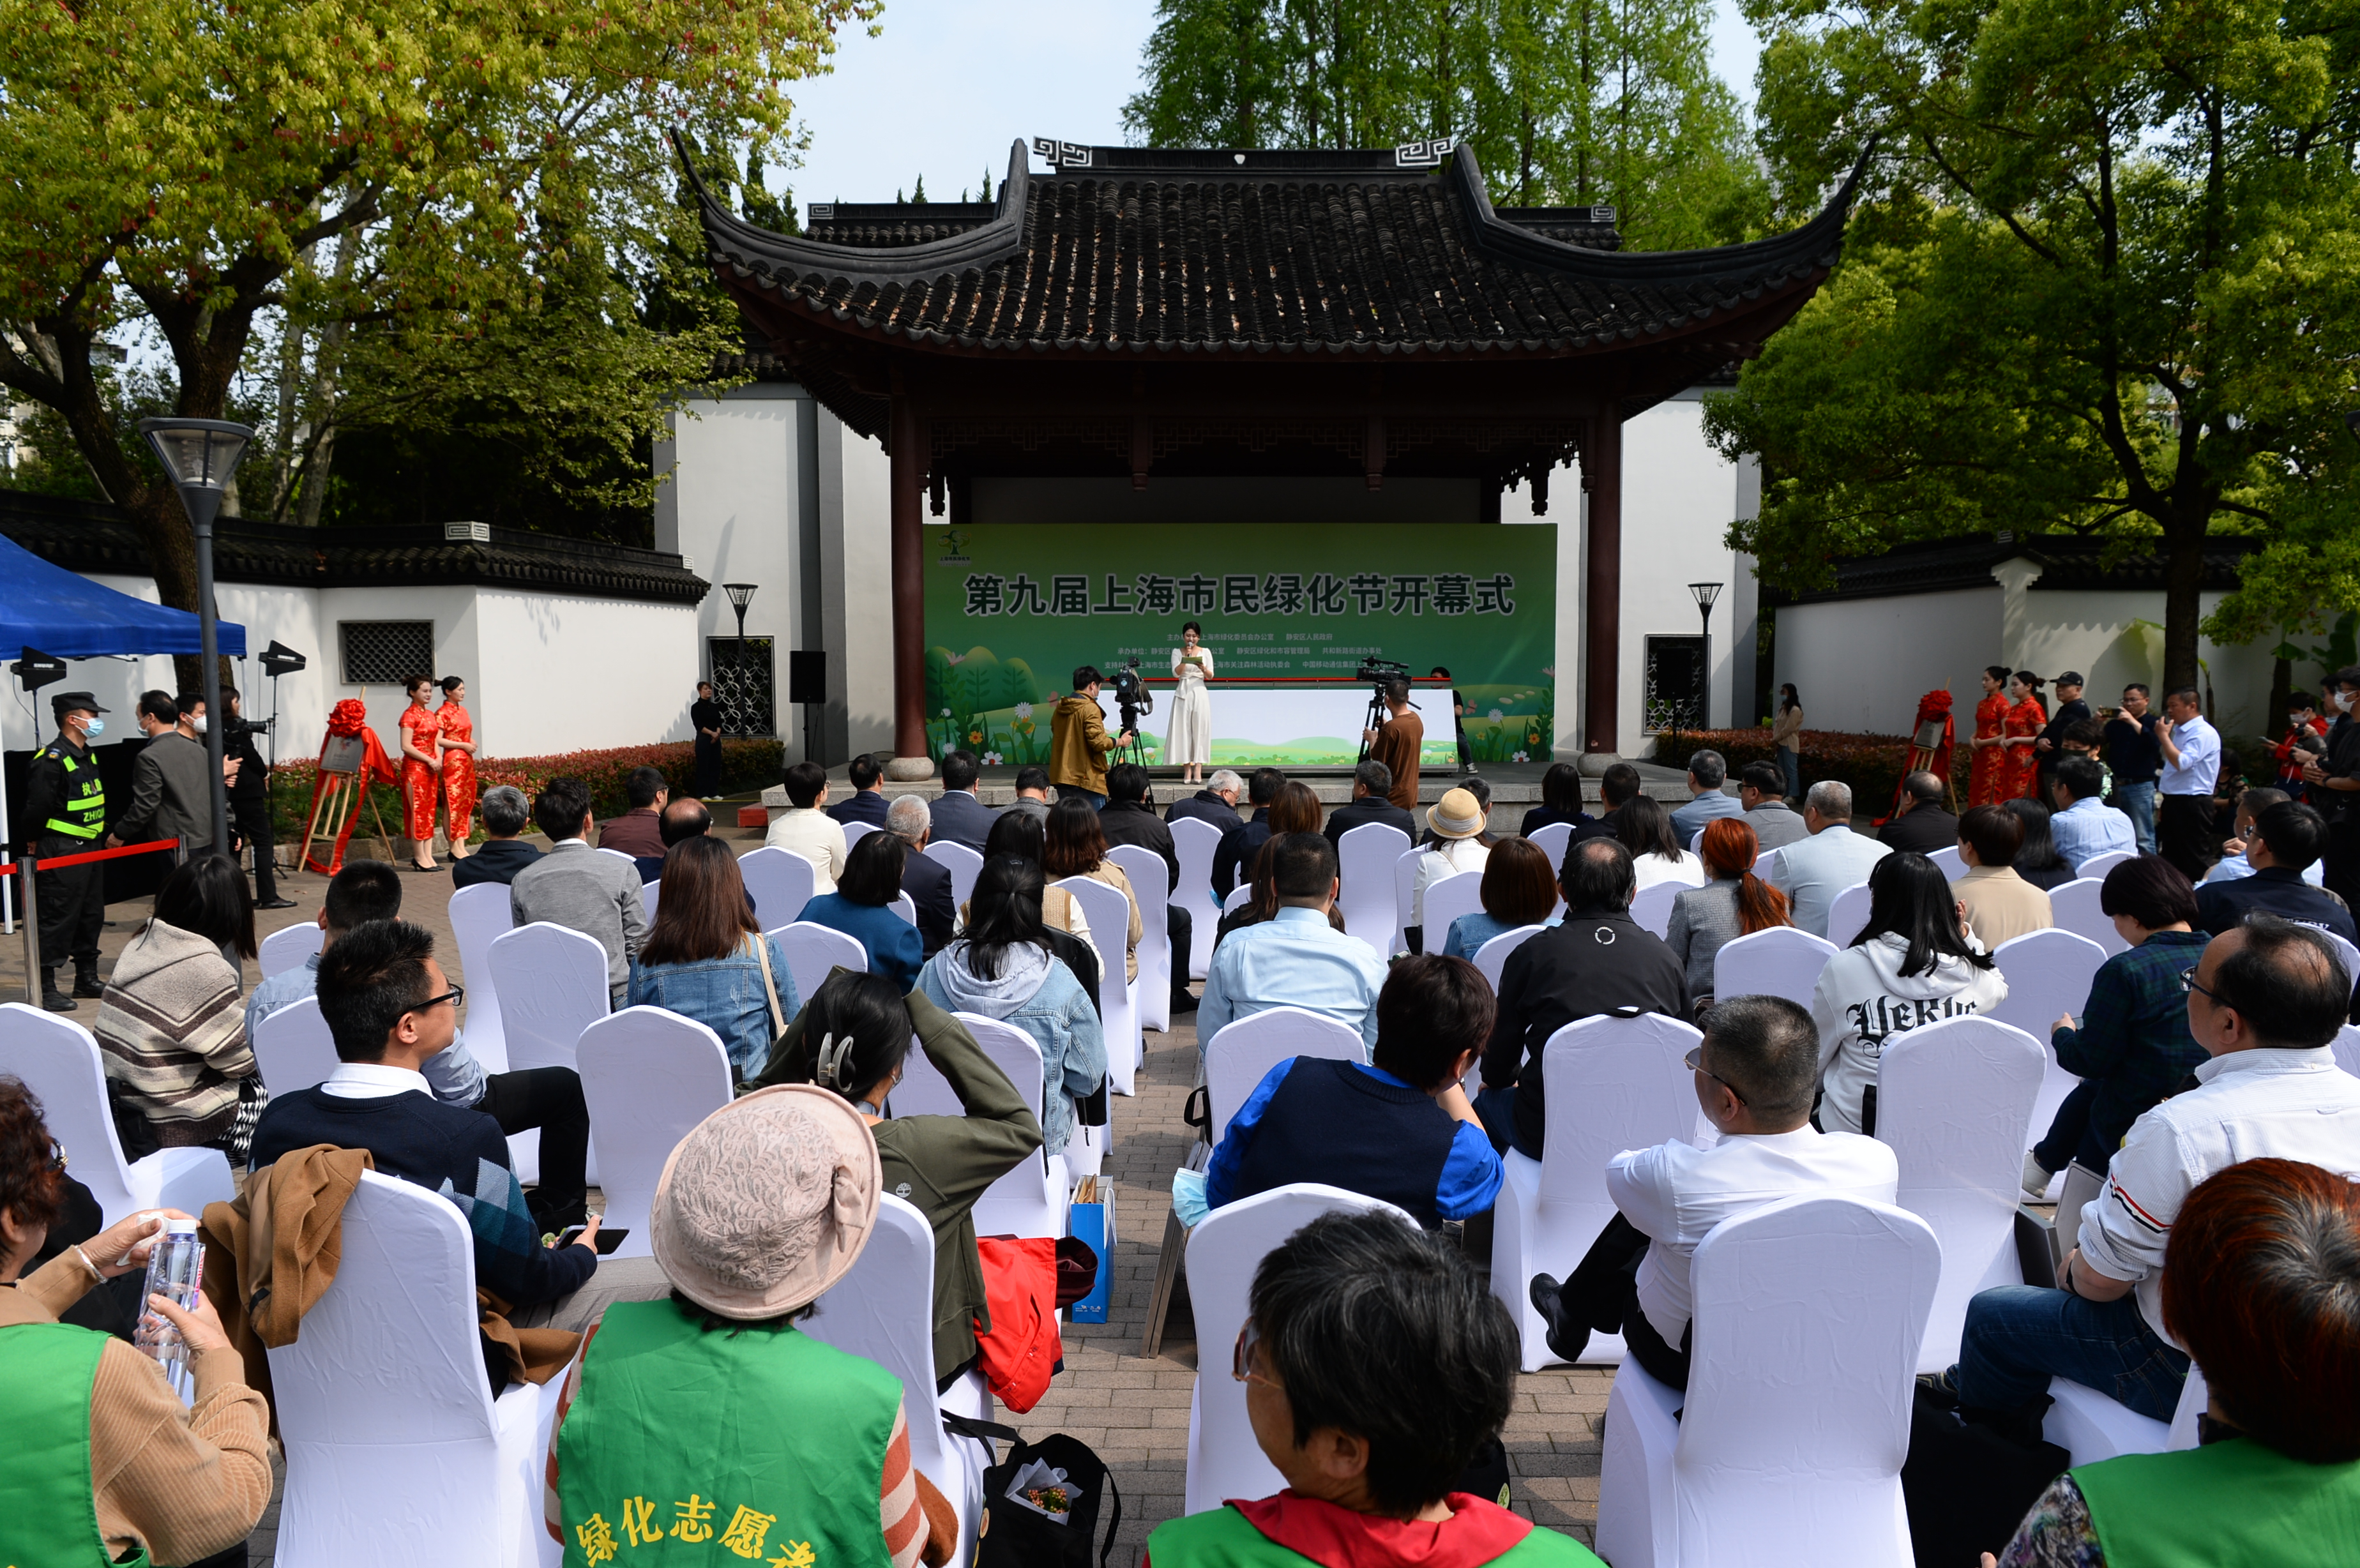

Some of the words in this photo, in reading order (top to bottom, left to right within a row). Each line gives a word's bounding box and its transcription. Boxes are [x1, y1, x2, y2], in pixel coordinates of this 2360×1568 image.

[964, 573, 1515, 615] 第九届上海市民绿化节开幕式
